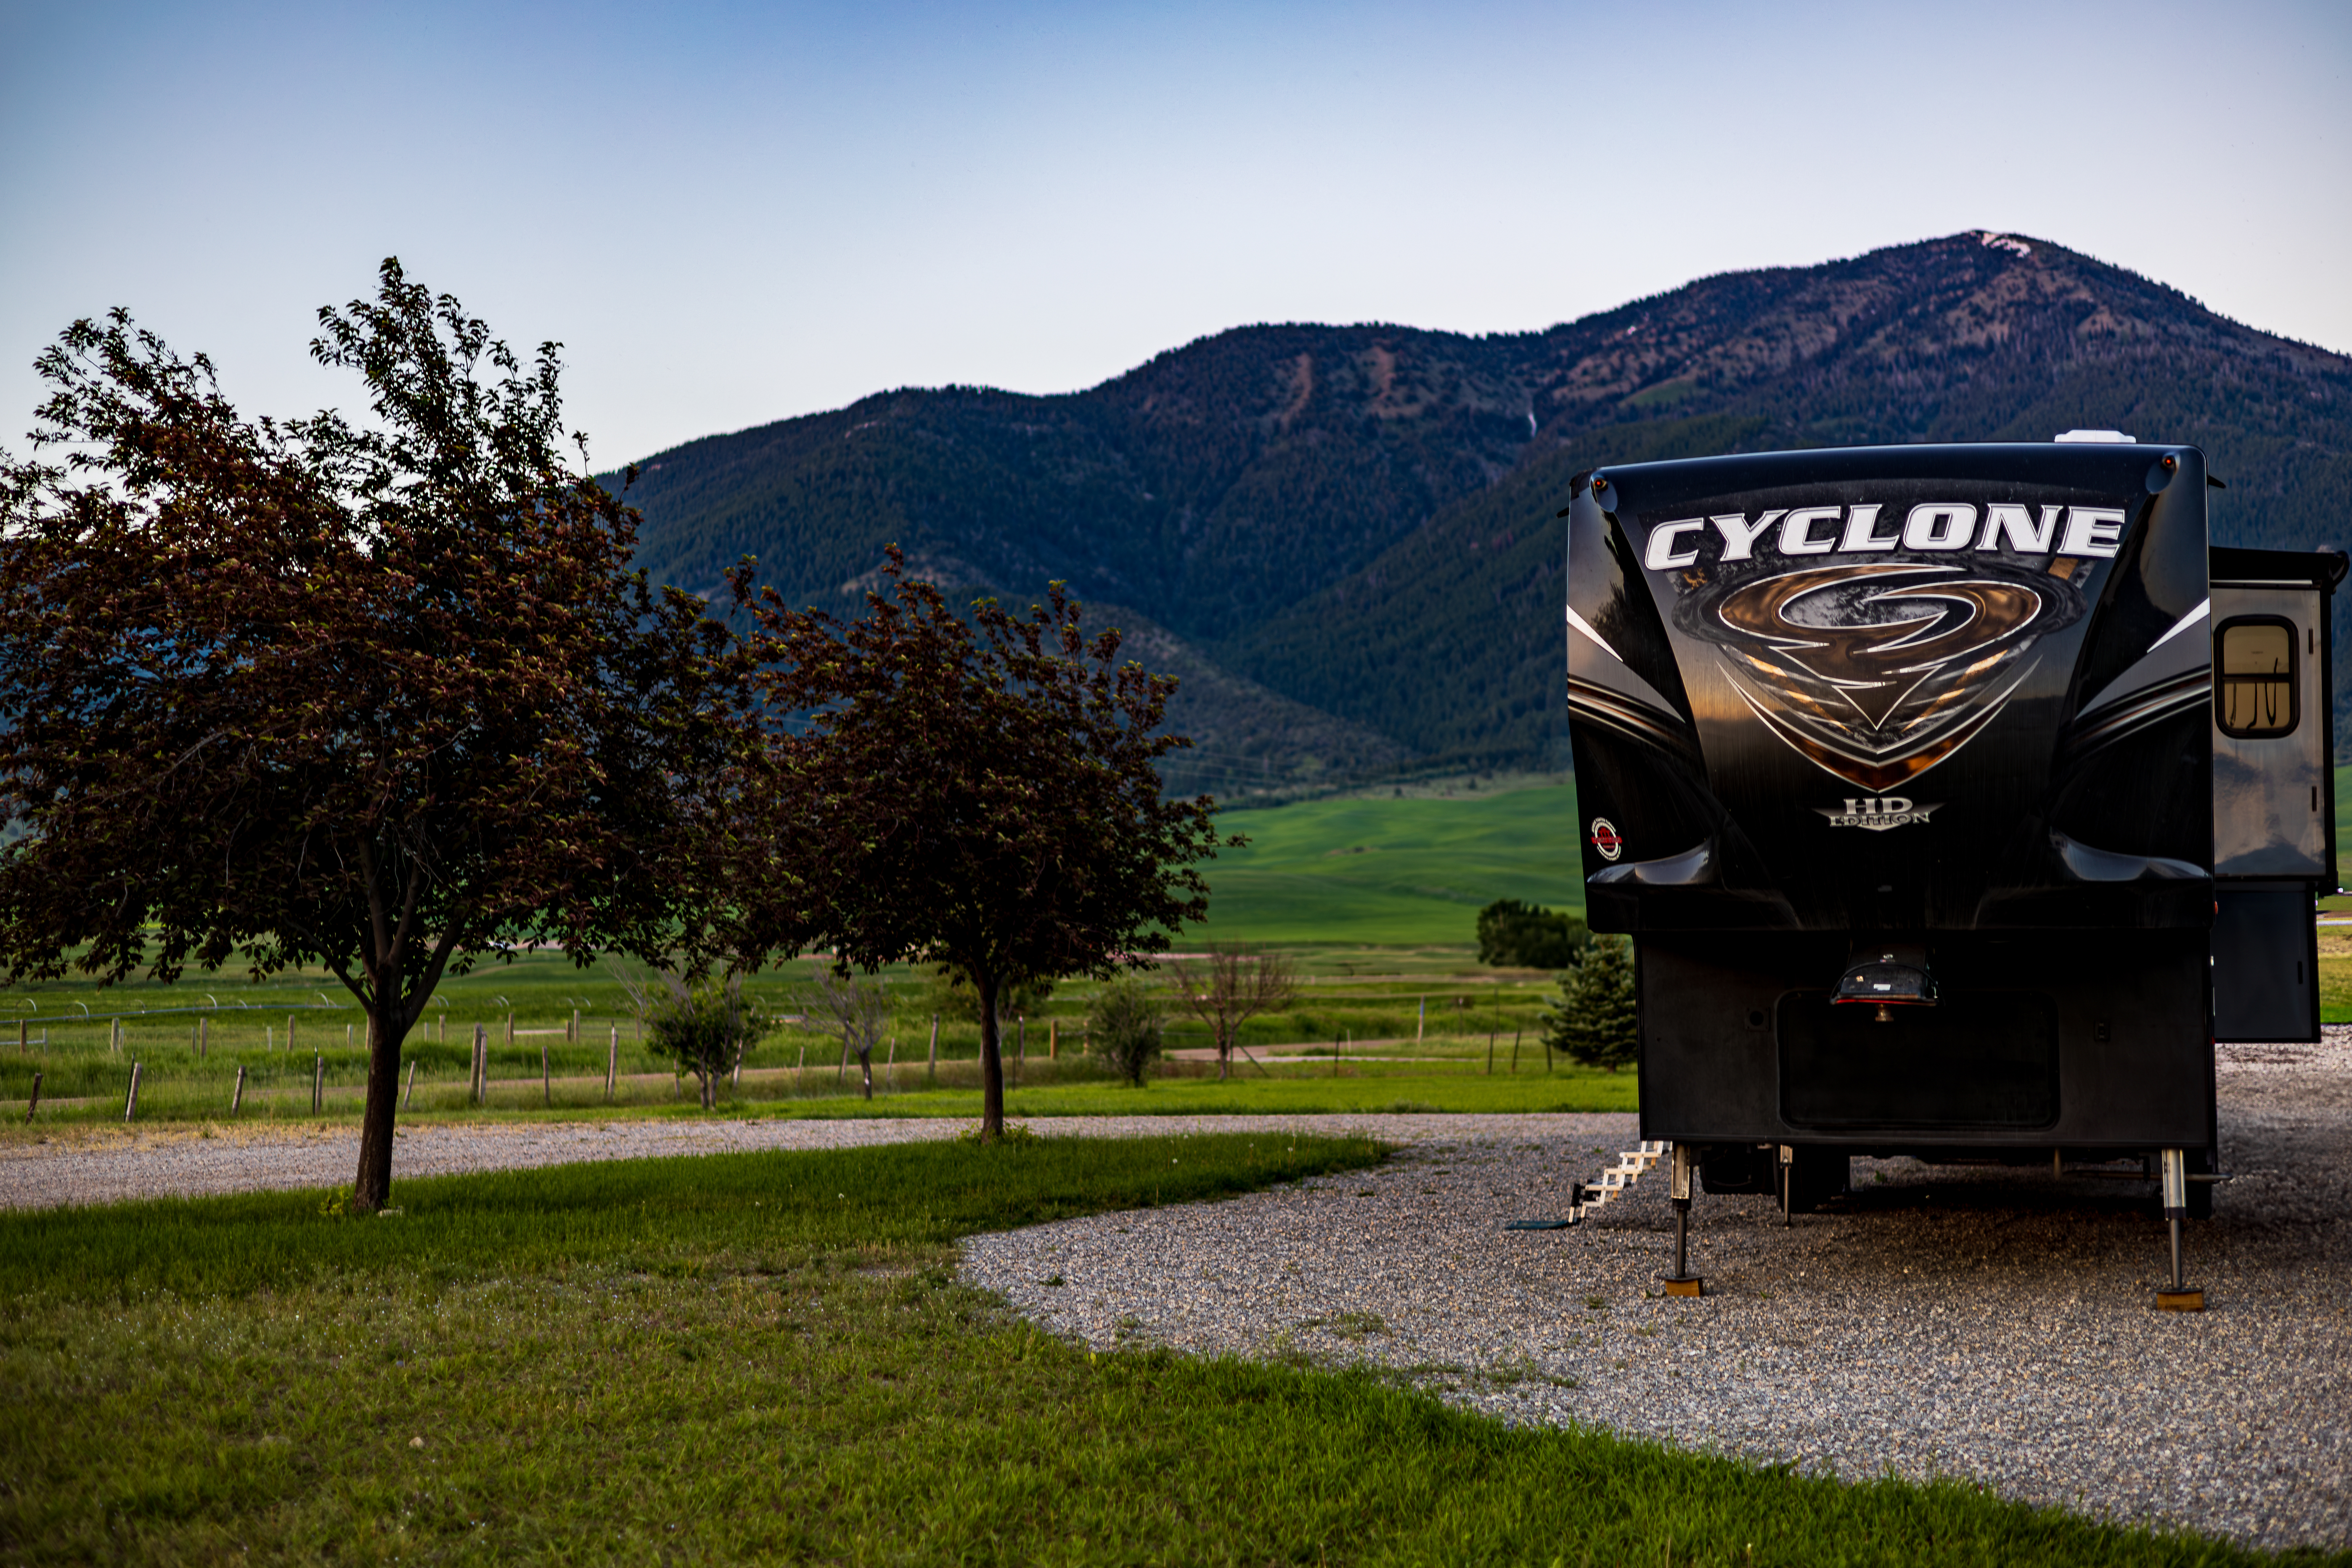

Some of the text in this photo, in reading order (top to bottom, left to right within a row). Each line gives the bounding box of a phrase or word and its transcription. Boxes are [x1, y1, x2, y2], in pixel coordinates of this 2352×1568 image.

[1645, 503, 2125, 570] CYCLONE
[1843, 797, 1913, 815] HD
[1829, 812, 1930, 827] EDITION
